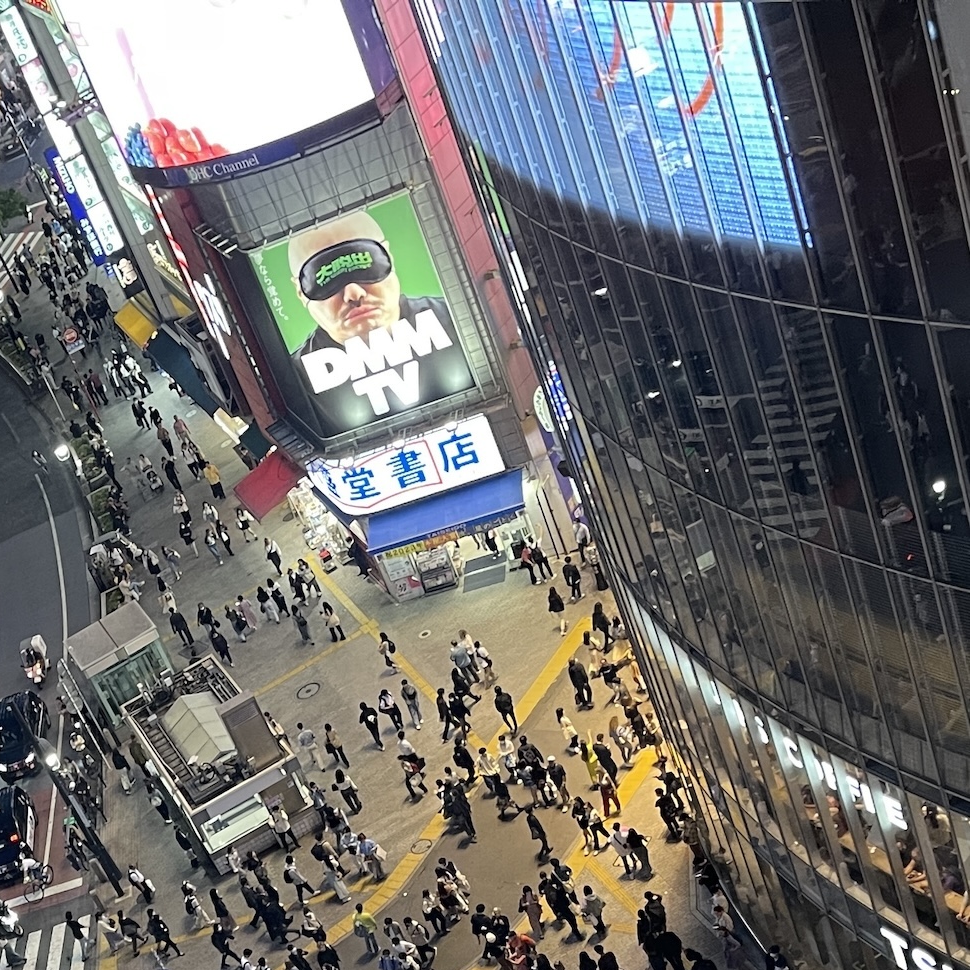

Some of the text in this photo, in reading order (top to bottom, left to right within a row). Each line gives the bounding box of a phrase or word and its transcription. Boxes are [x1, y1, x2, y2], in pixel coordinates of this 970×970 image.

[213, 153, 259, 175] Channel
[316, 251, 372, 283] 大脱出
[301, 309, 453, 394] DMM
[352, 360, 419, 415] TV
